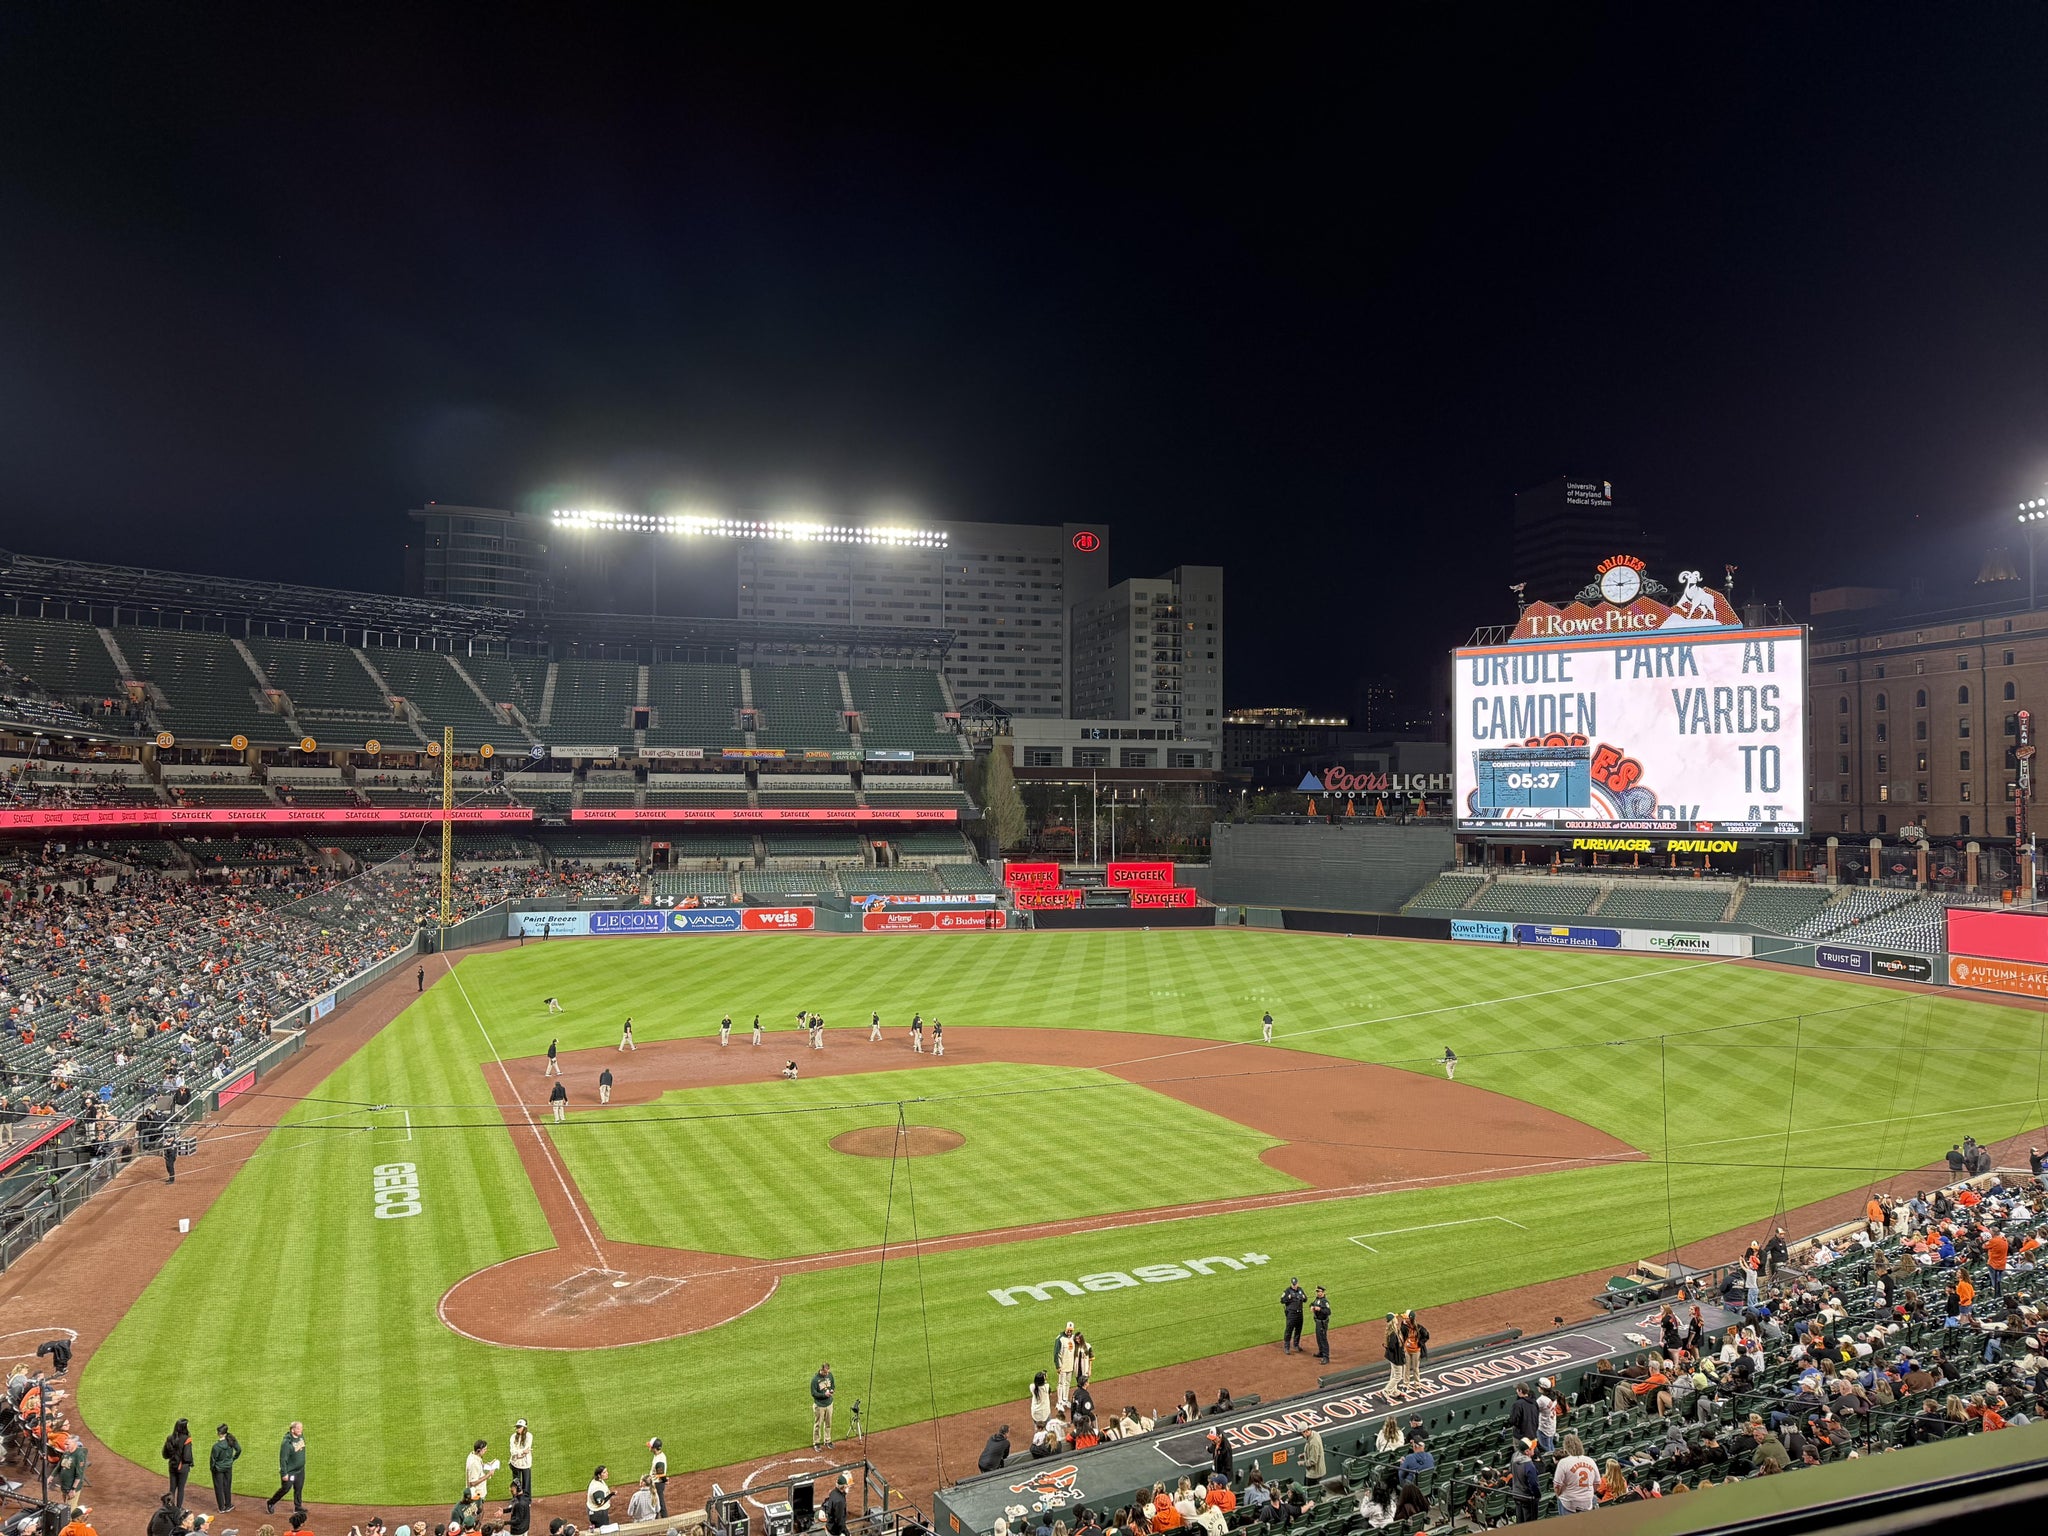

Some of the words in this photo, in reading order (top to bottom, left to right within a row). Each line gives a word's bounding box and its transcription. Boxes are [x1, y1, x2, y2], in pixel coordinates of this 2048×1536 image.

[1566, 482, 1596, 491] University
[1597, 554, 1645, 574] ORIOLES
[1605, 610, 1657, 631] Price
[1472, 692, 1596, 740] CAMDEN
[1671, 684, 1780, 734] YARDS
[2020, 718, 2028, 745] TEAM
[159, 736, 172, 745] 20
[532, 748, 542, 756] 42
[1738, 745, 1780, 794] TO
[1324, 766, 1390, 790] Coors
[1508, 772, 1560, 789] 05:37
[1322, 791, 1367, 799] ROOF
[1382, 791, 1427, 799] DECK
[172, 811, 213, 820] SEATGEEK
[228, 811, 267, 820] SEATGEEK
[288, 811, 325, 820] SEATGEEK
[345, 811, 380, 820] SEATGEEK
[400, 811, 433, 820] SEATGEEK
[451, 811, 483, 820] SEATGEEK
[500, 811, 530, 820] SEATGEEK
[1620, 822, 1652, 830] CAMDEN
[1653, 822, 1677, 830] YARDS
[1572, 838, 1651, 851] PUREWAGER
[1667, 840, 1738, 854] PAVILION
[1114, 870, 1166, 882] SEATGEEK
[920, 894, 943, 902] BIRD
[944, 894, 969, 902] BATH
[1136, 892, 1188, 905] SEATGEEK
[597, 914, 658, 926] LECOM
[688, 916, 734, 924] VANDA
[758, 910, 798, 923] weis
[888, 914, 912, 922] Airtemp
[1452, 922, 1476, 932] Rowe
[1476, 924, 1500, 934] Price
[1535, 936, 1568, 944] MedStar
[1570, 938, 1598, 946] Health
[1668, 938, 1710, 948] RANKIN
[1822, 952, 1850, 964] TRUIST
[1972, 966, 2017, 979] AUTUMN
[2020, 972, 2048, 984] LAKE
[373, 1162, 422, 1219] GEICO
[987, 1252, 1272, 1307] masn+
[1223, 1408, 1335, 1450] HOME
[1322, 1397, 1374, 1419] OF
[1368, 1378, 1450, 1409] THE
[1437, 1345, 1573, 1388] ORIOLES
[1579, 1470, 1588, 1488] 2
